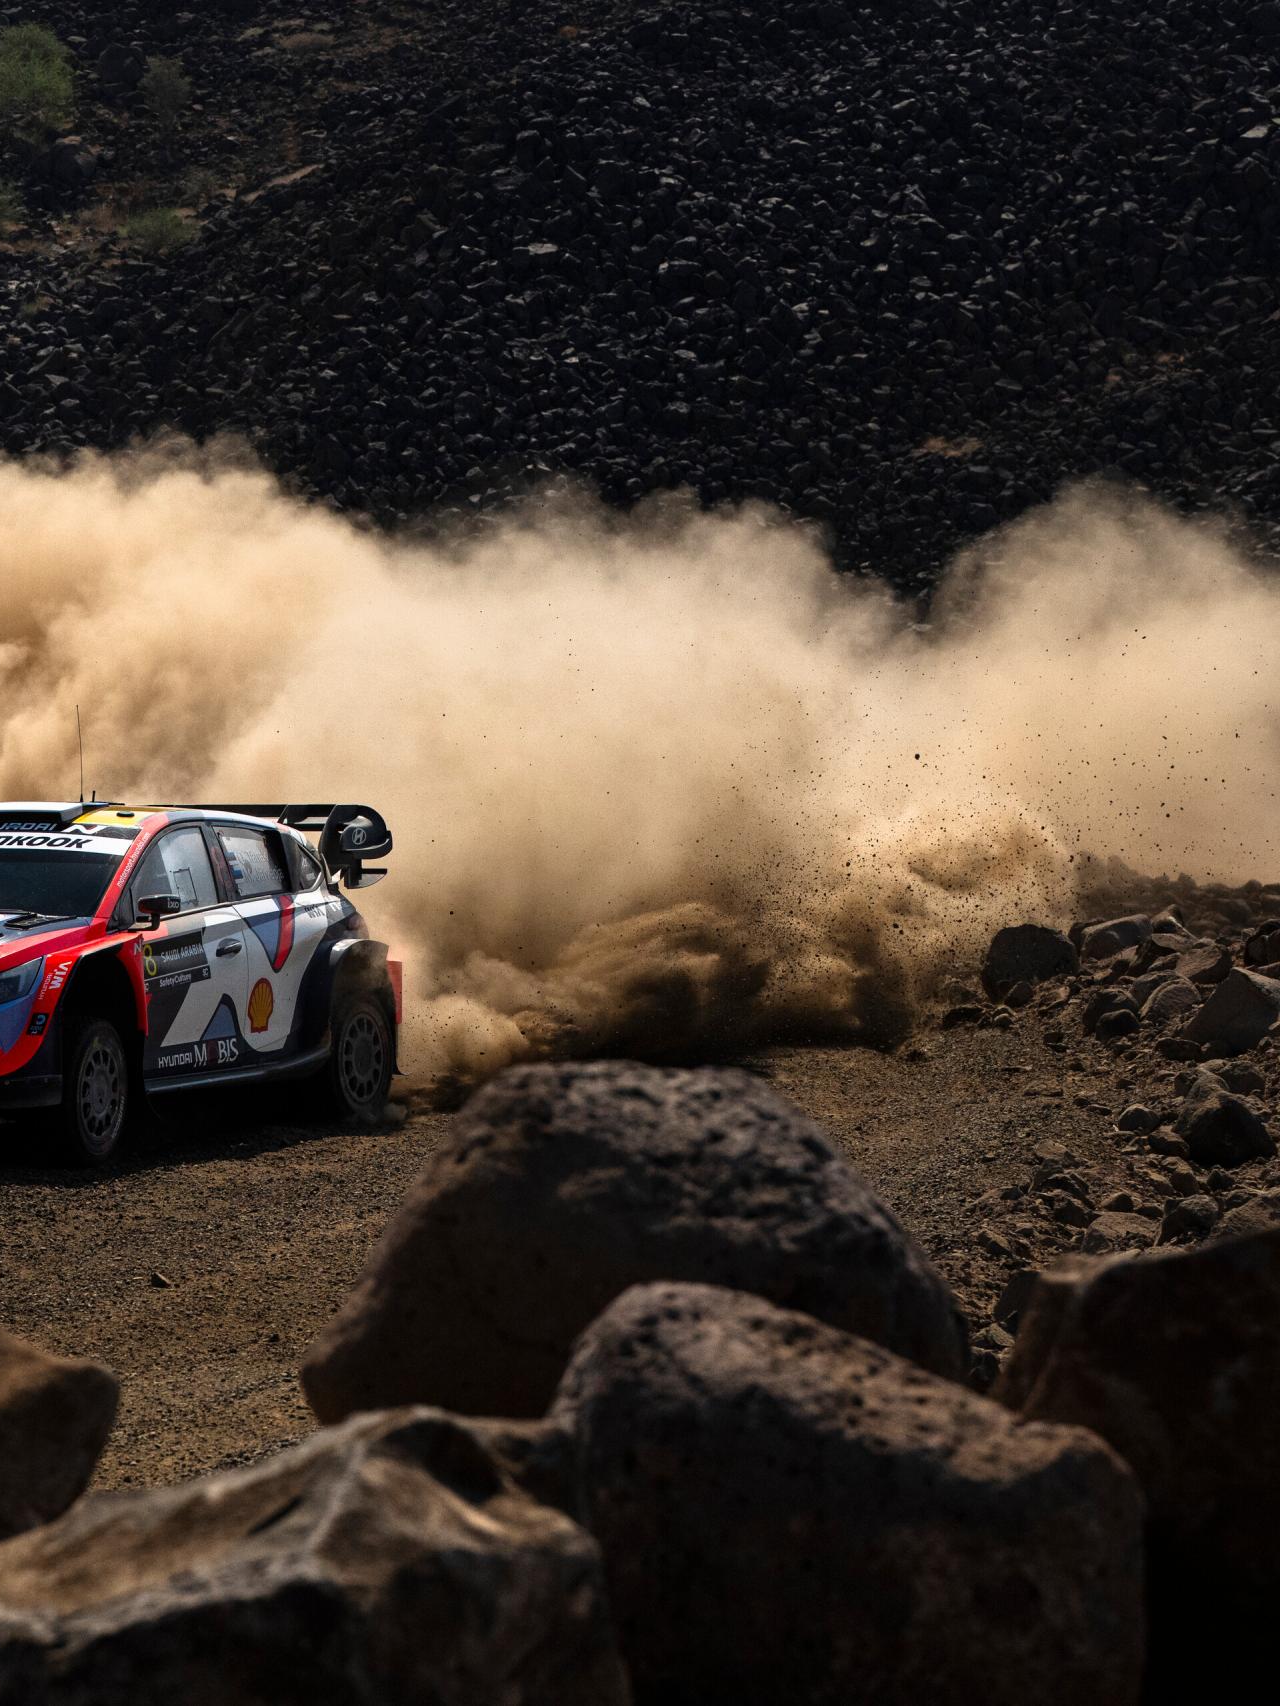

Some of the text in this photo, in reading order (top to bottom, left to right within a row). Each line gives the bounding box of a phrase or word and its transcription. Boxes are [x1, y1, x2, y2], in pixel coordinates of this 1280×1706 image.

[143, 943, 158, 977] 8
[160, 943, 204, 963] SAUDI ARABIA
[159, 973, 192, 988] SafetyCulture
[158, 1051, 193, 1069] HYUNDAI
